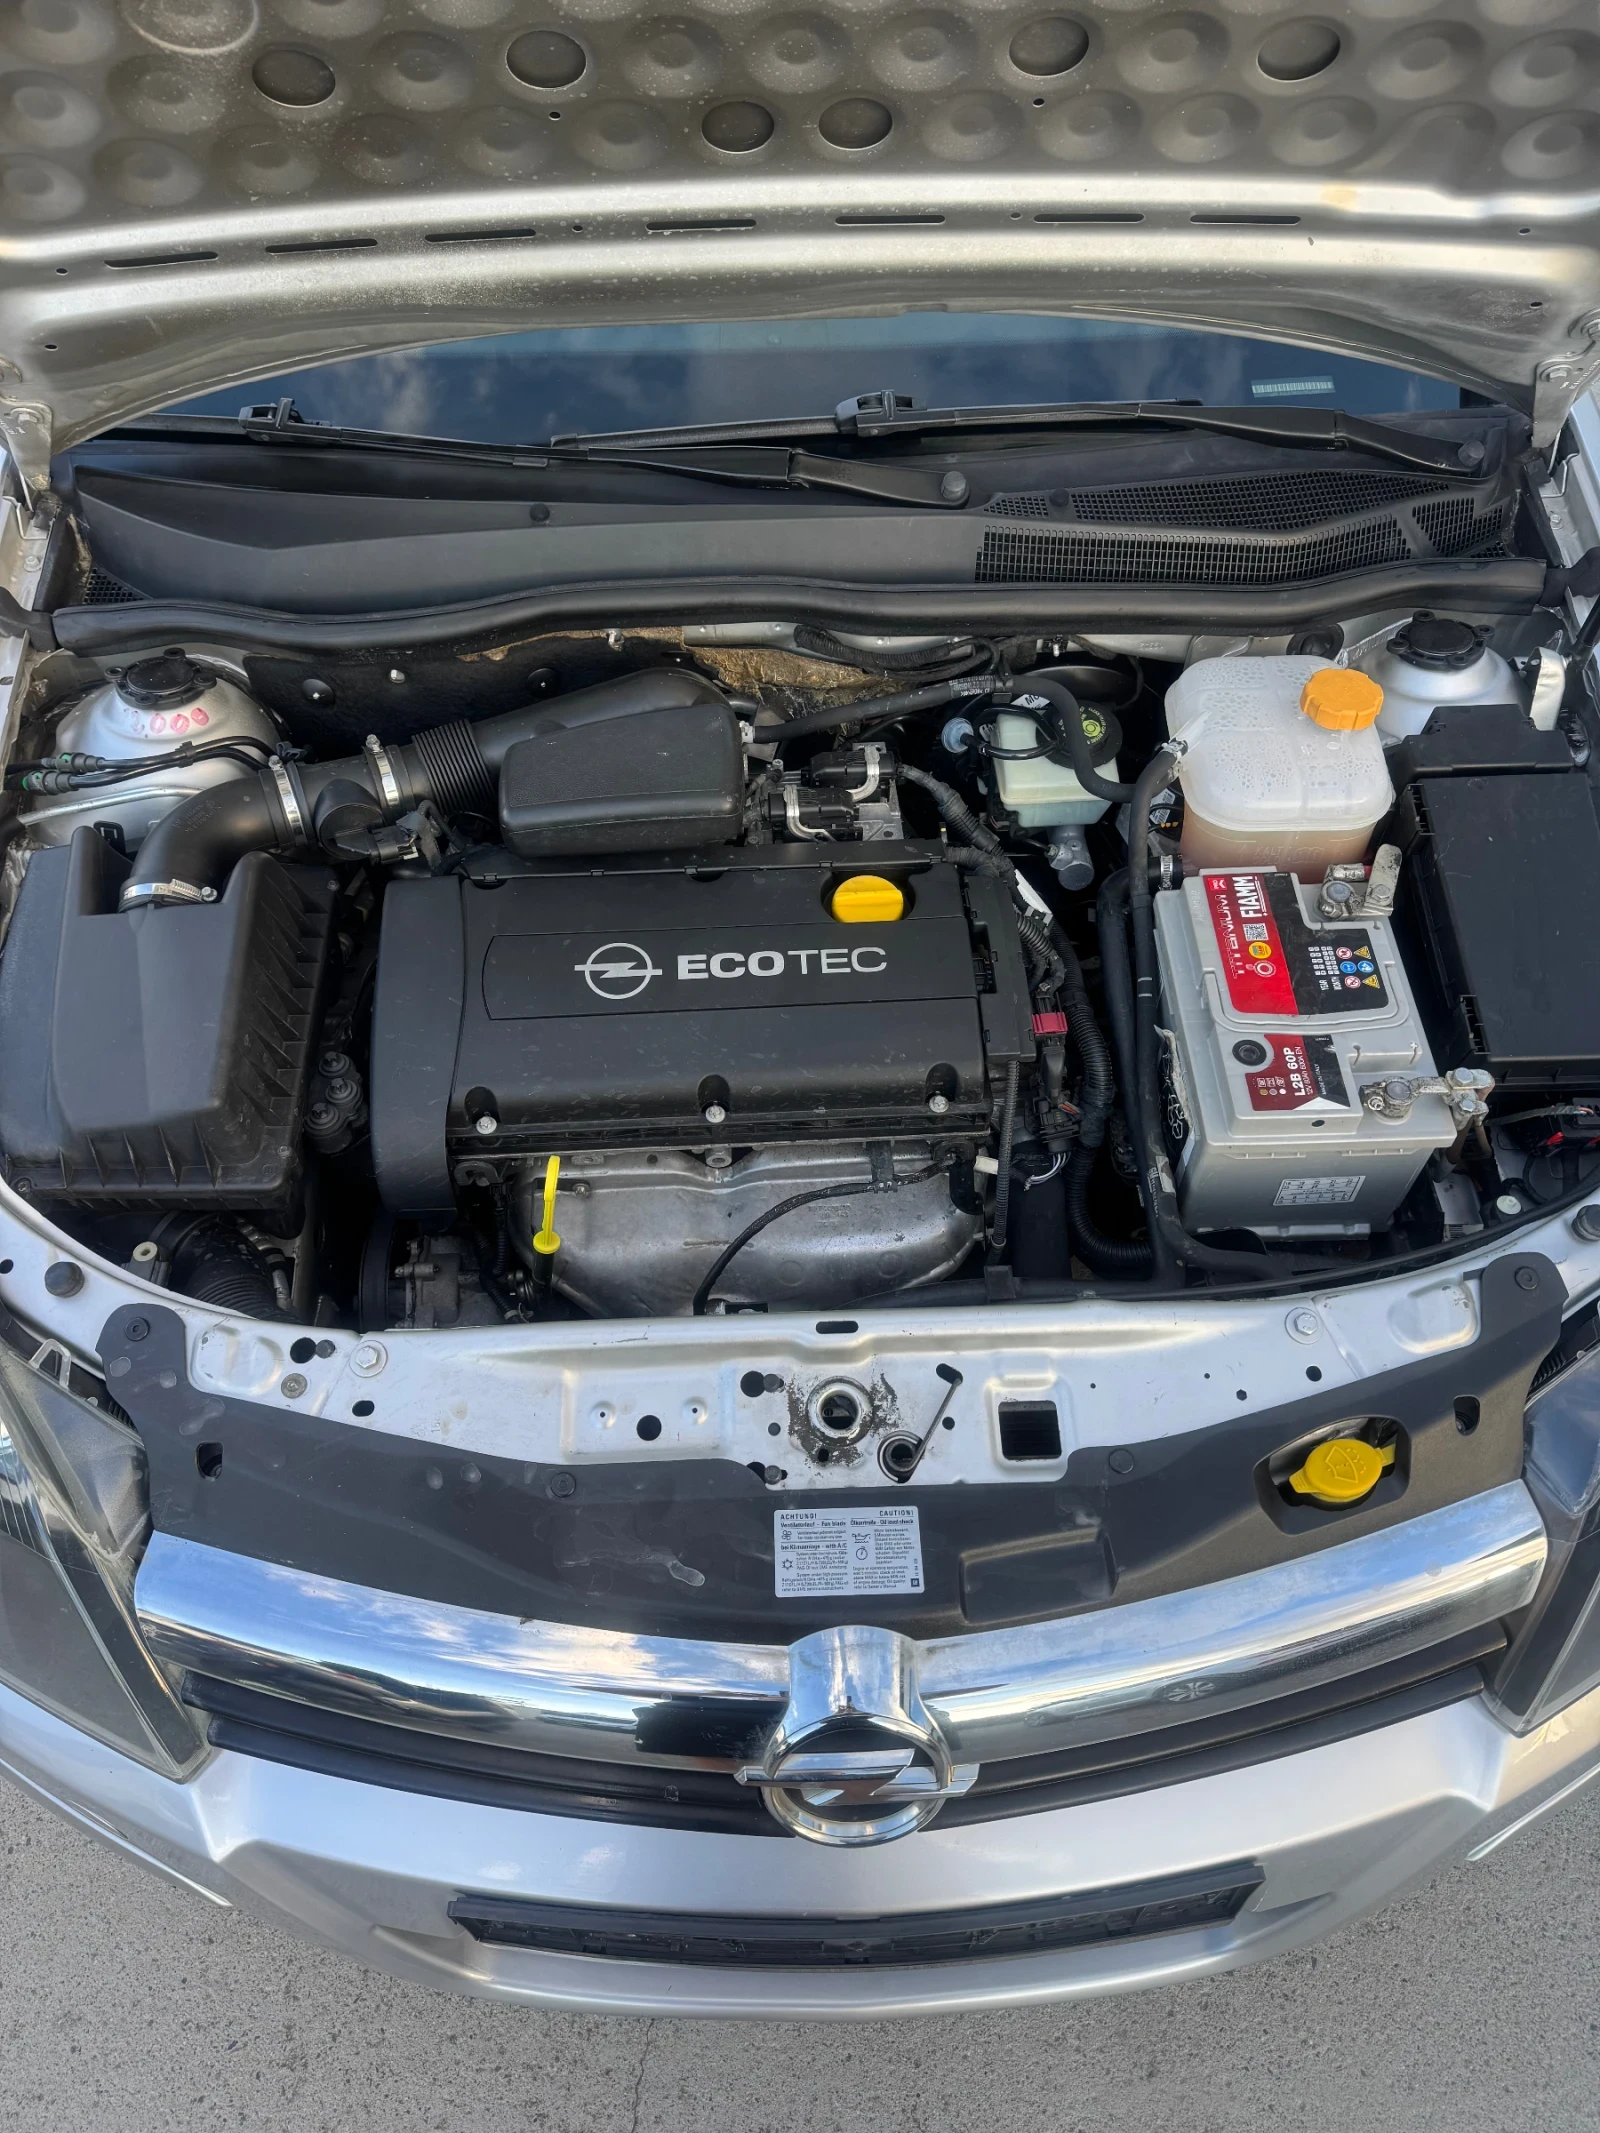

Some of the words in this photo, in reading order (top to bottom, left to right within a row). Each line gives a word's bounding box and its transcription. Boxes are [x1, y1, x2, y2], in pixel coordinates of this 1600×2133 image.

[1232, 875, 1263, 918] FIAMM
[677, 947, 888, 980] ECOTEC
[1283, 1047, 1298, 1070] 60P
[1295, 1046, 1303, 1054] EN
[1290, 1073, 1306, 1096] L2B
